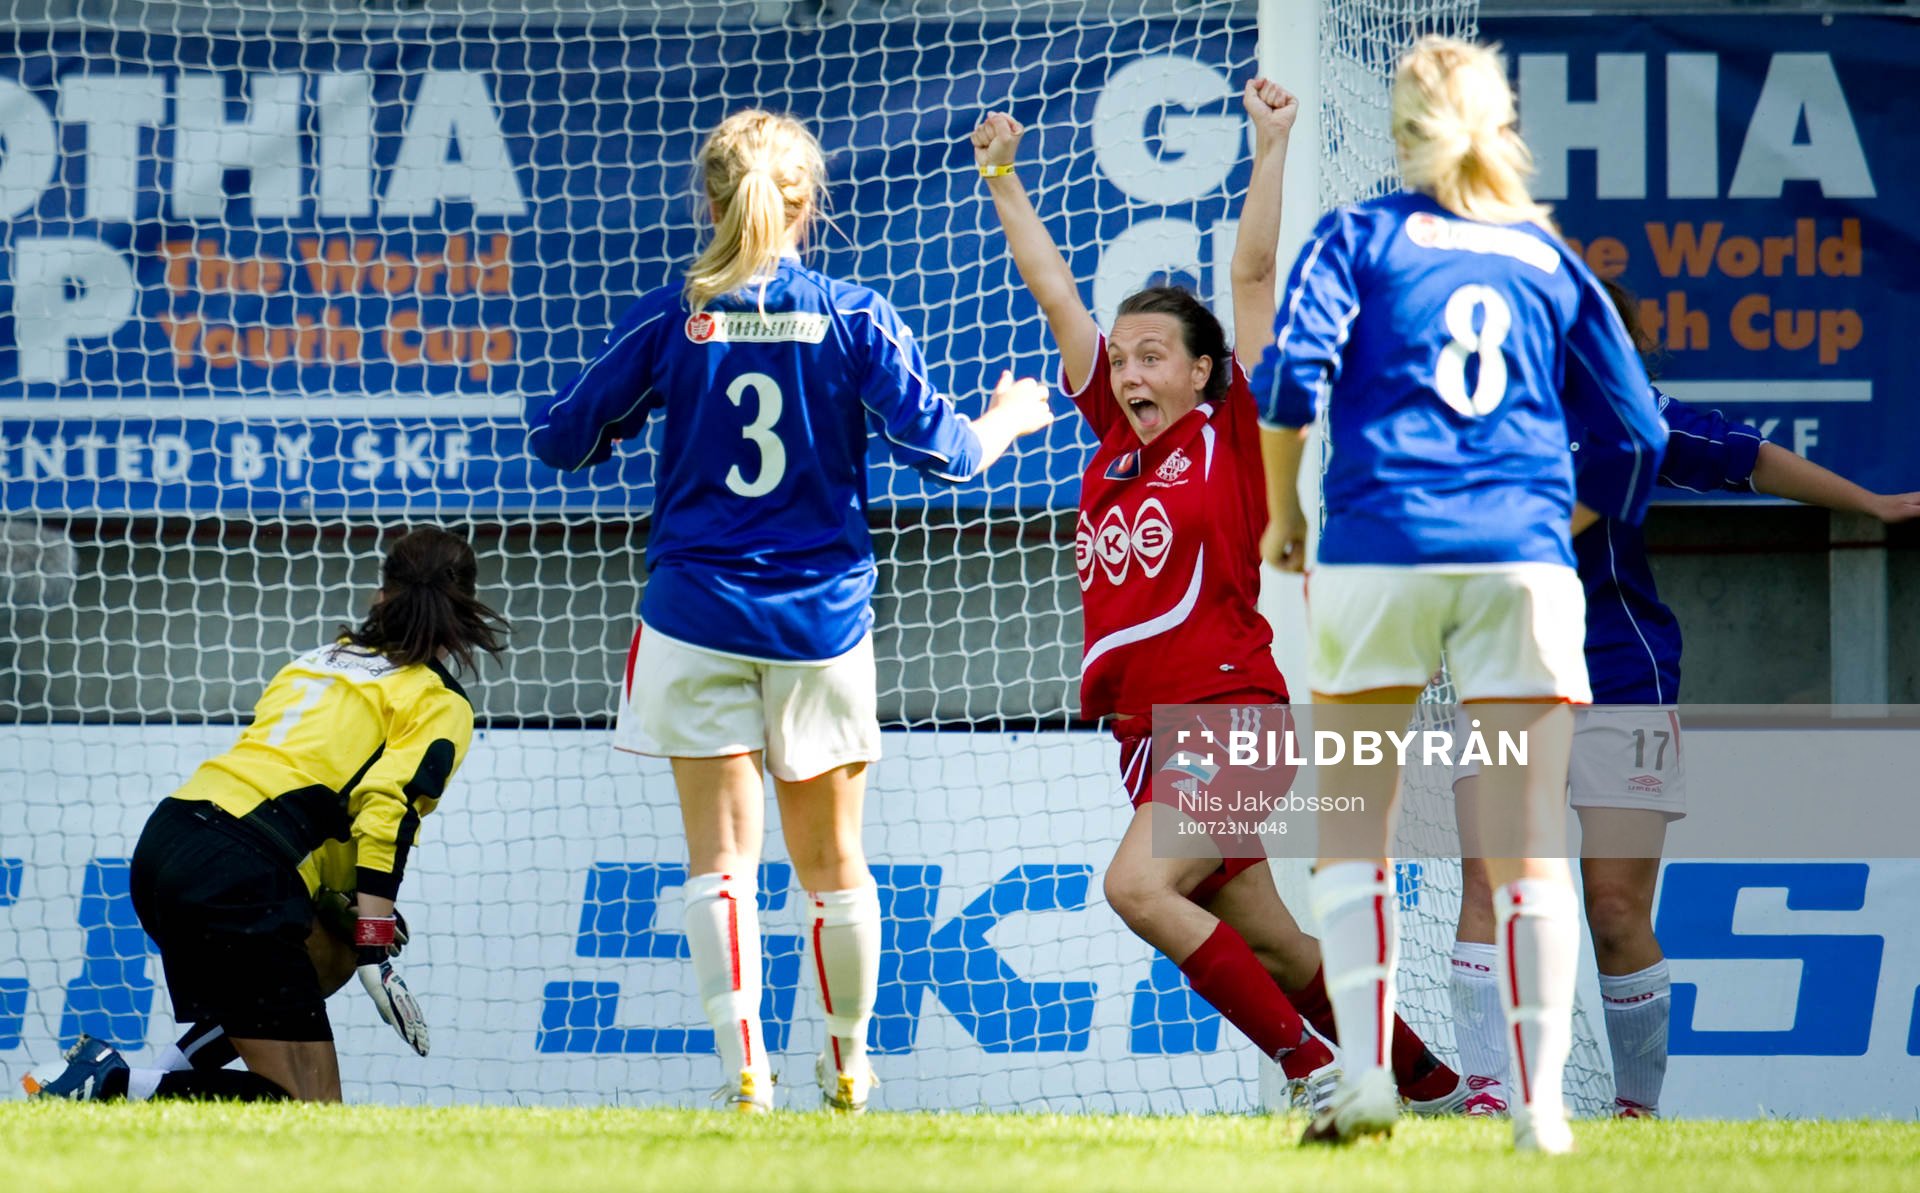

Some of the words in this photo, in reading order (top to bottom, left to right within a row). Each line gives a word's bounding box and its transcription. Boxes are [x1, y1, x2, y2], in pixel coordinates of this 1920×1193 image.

[157, 240, 284, 295] The
[299, 233, 512, 295] World
[1645, 218, 1862, 278] World
[157, 308, 362, 369] Youth
[382, 309, 515, 382] Cup
[1436, 284, 1512, 417] 8
[1729, 293, 1864, 365] Cup
[231, 433, 313, 481] BY
[350, 432, 472, 481] SKF
[725, 372, 787, 498] 3
[1632, 729, 1670, 771] 17
